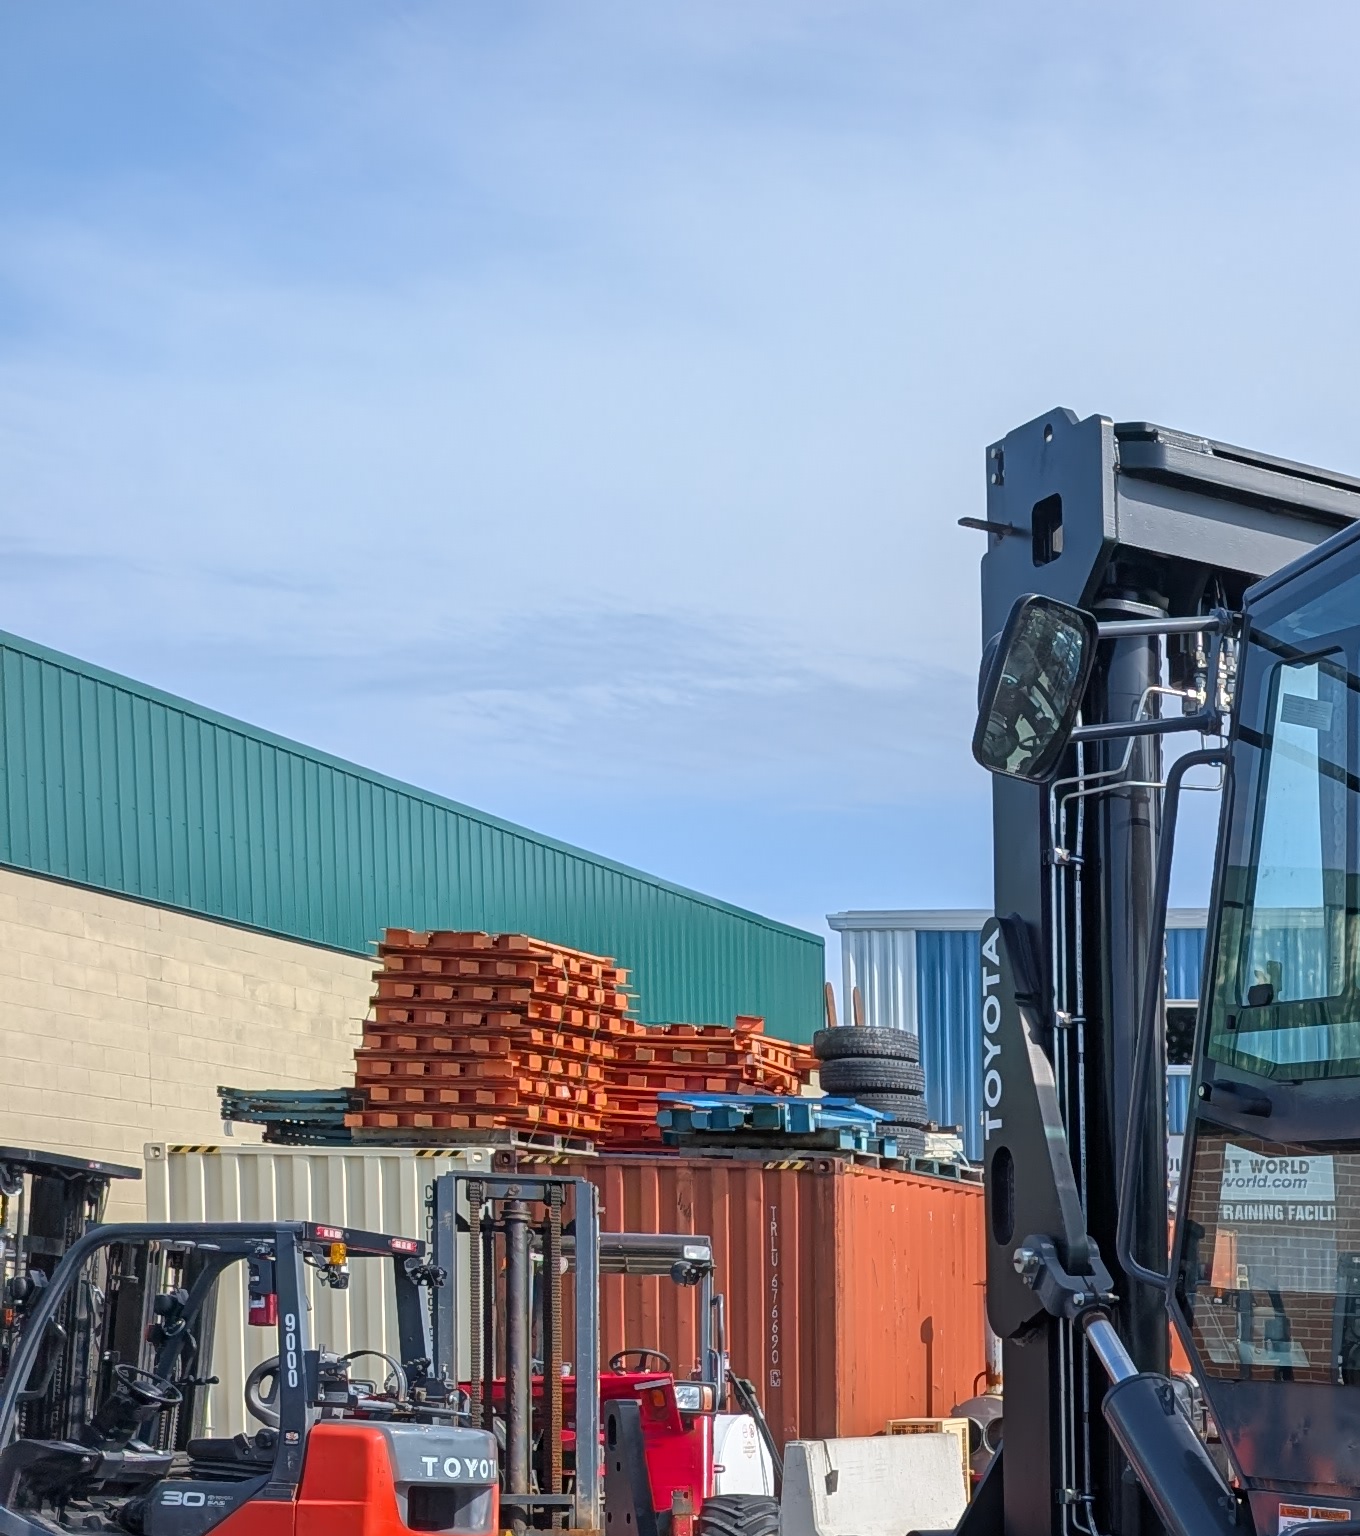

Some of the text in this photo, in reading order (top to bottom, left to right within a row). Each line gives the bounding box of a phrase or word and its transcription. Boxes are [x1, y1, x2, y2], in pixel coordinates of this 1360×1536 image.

[982, 927, 1003, 1140] TOYOTA
[1249, 1159, 1310, 1174] WORLD
[770, 1206, 778, 1266] TRLU
[1220, 1204, 1284, 1221] RAINING
[771, 1274, 779, 1364] 676690
[285, 1313, 298, 1388] 9000
[160, 1490, 206, 1507] 30
